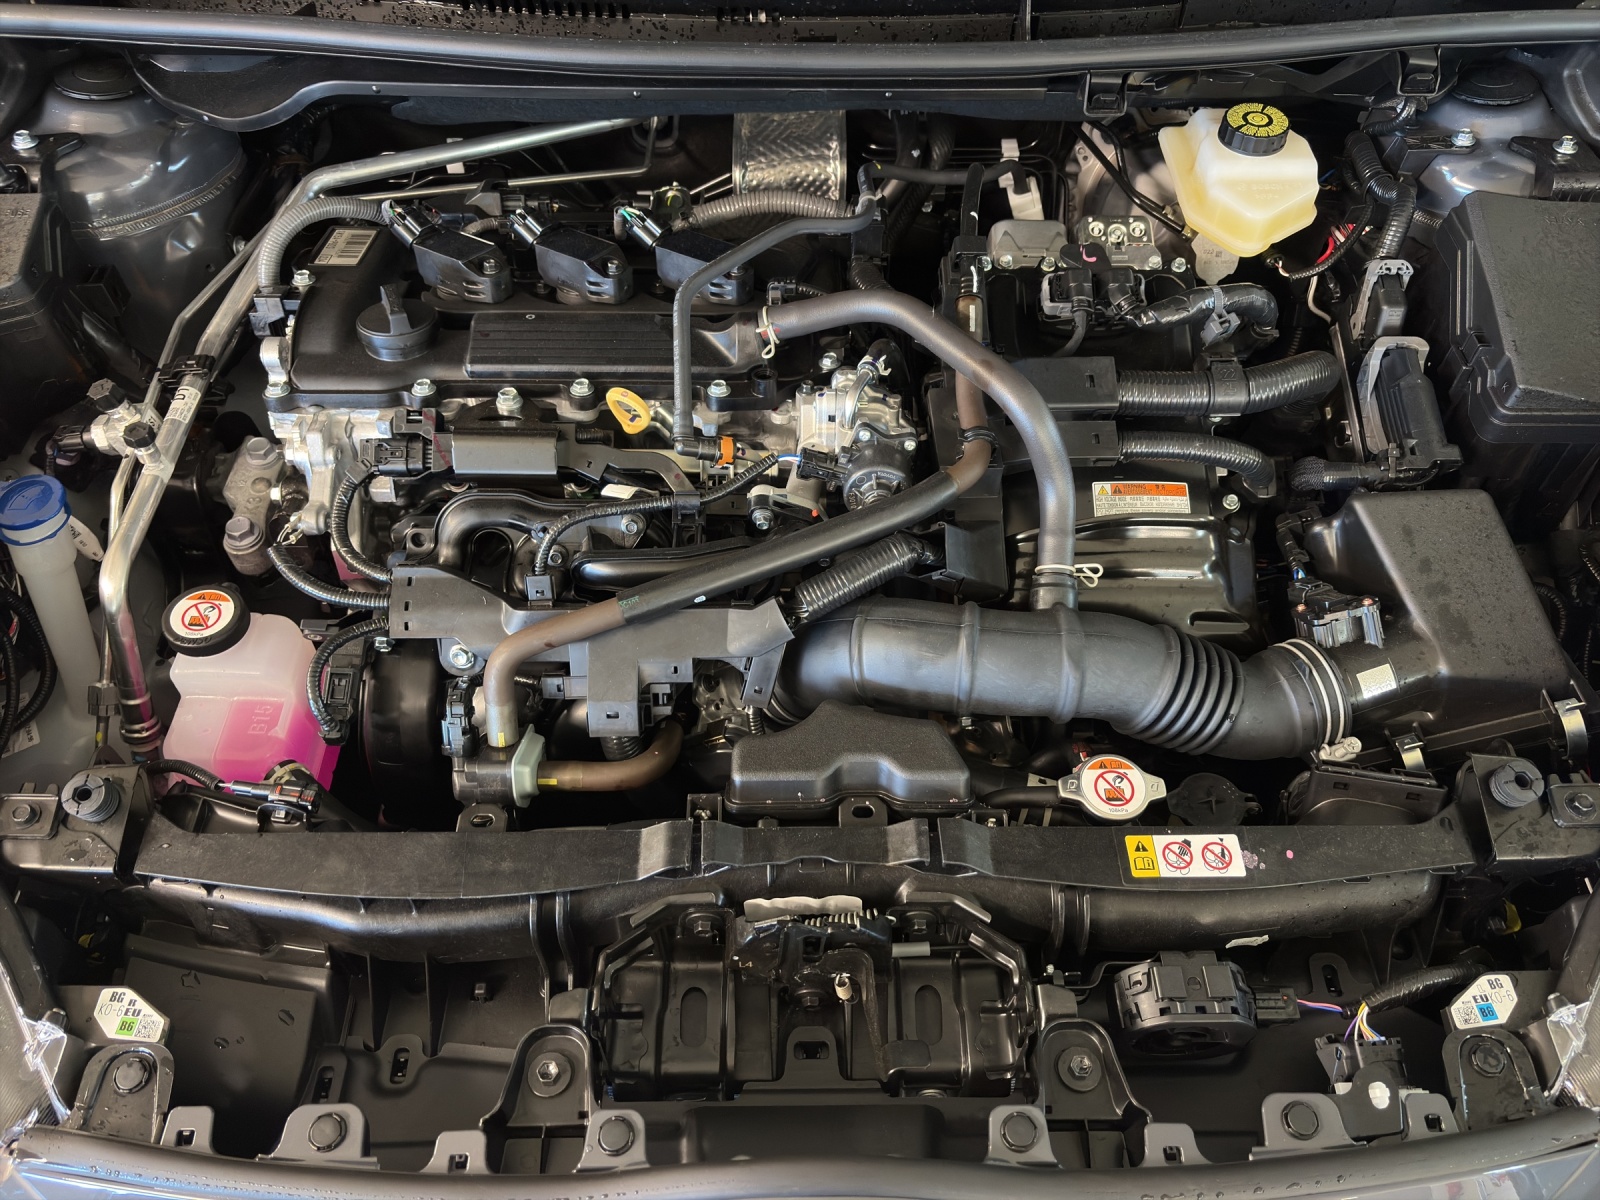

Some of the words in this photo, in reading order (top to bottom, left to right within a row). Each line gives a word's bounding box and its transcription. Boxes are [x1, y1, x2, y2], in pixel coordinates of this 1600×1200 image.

[1486, 978, 1504, 990] BG
[109, 991, 126, 1003] BG
[127, 998, 137, 1007] R
[1472, 993, 1489, 1004] EU
[124, 1008, 142, 1017] EU
[1479, 1006, 1495, 1018] B6
[119, 1020, 135, 1032] B6
